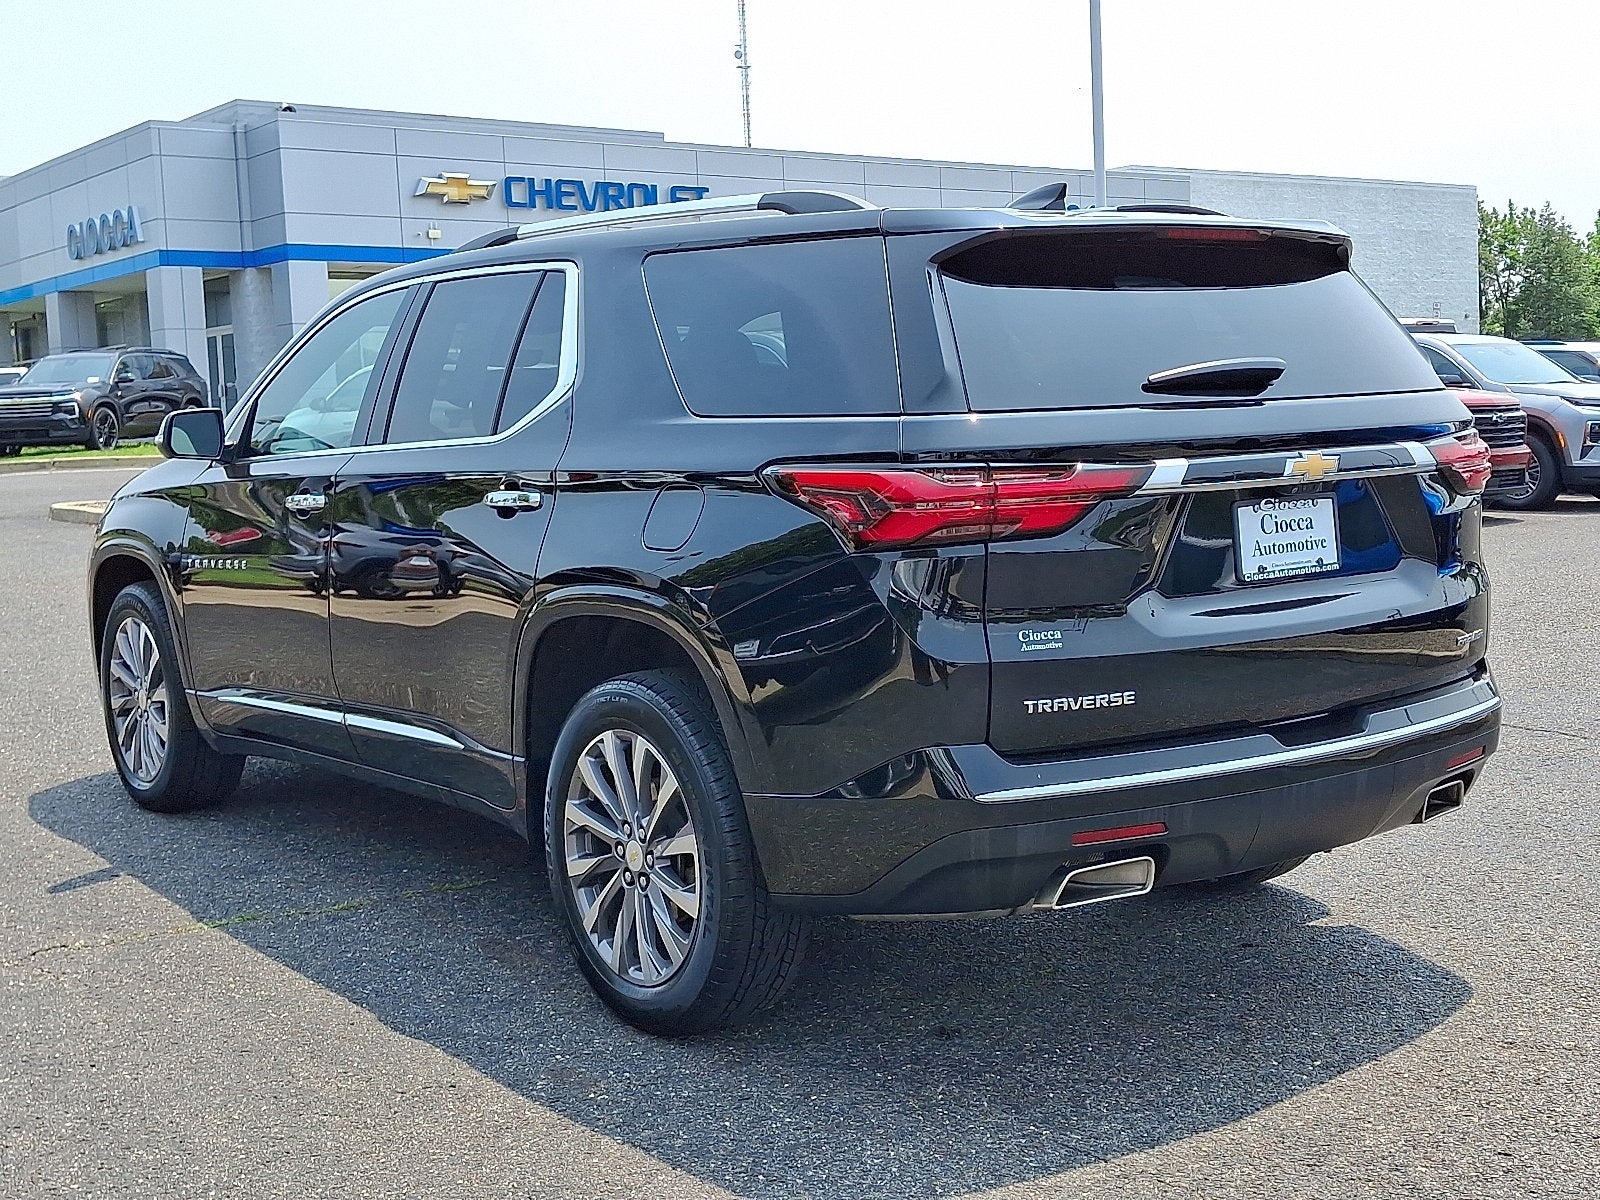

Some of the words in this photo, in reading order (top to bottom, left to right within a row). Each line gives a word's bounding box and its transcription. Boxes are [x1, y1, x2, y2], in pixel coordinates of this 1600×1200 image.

[67, 206, 141, 260] CIOCCA
[1260, 498, 1312, 511] Ciocca
[1260, 513, 1314, 534] Ciocca
[1252, 535, 1327, 557] Automotive
[187, 558, 247, 570] TRAVERSE
[1244, 563, 1340, 582] CioccaAutomotive.com
[1018, 629, 1062, 642] Ciocca
[1020, 641, 1063, 652] Automotive
[1023, 691, 1136, 714] TRAVERSE
